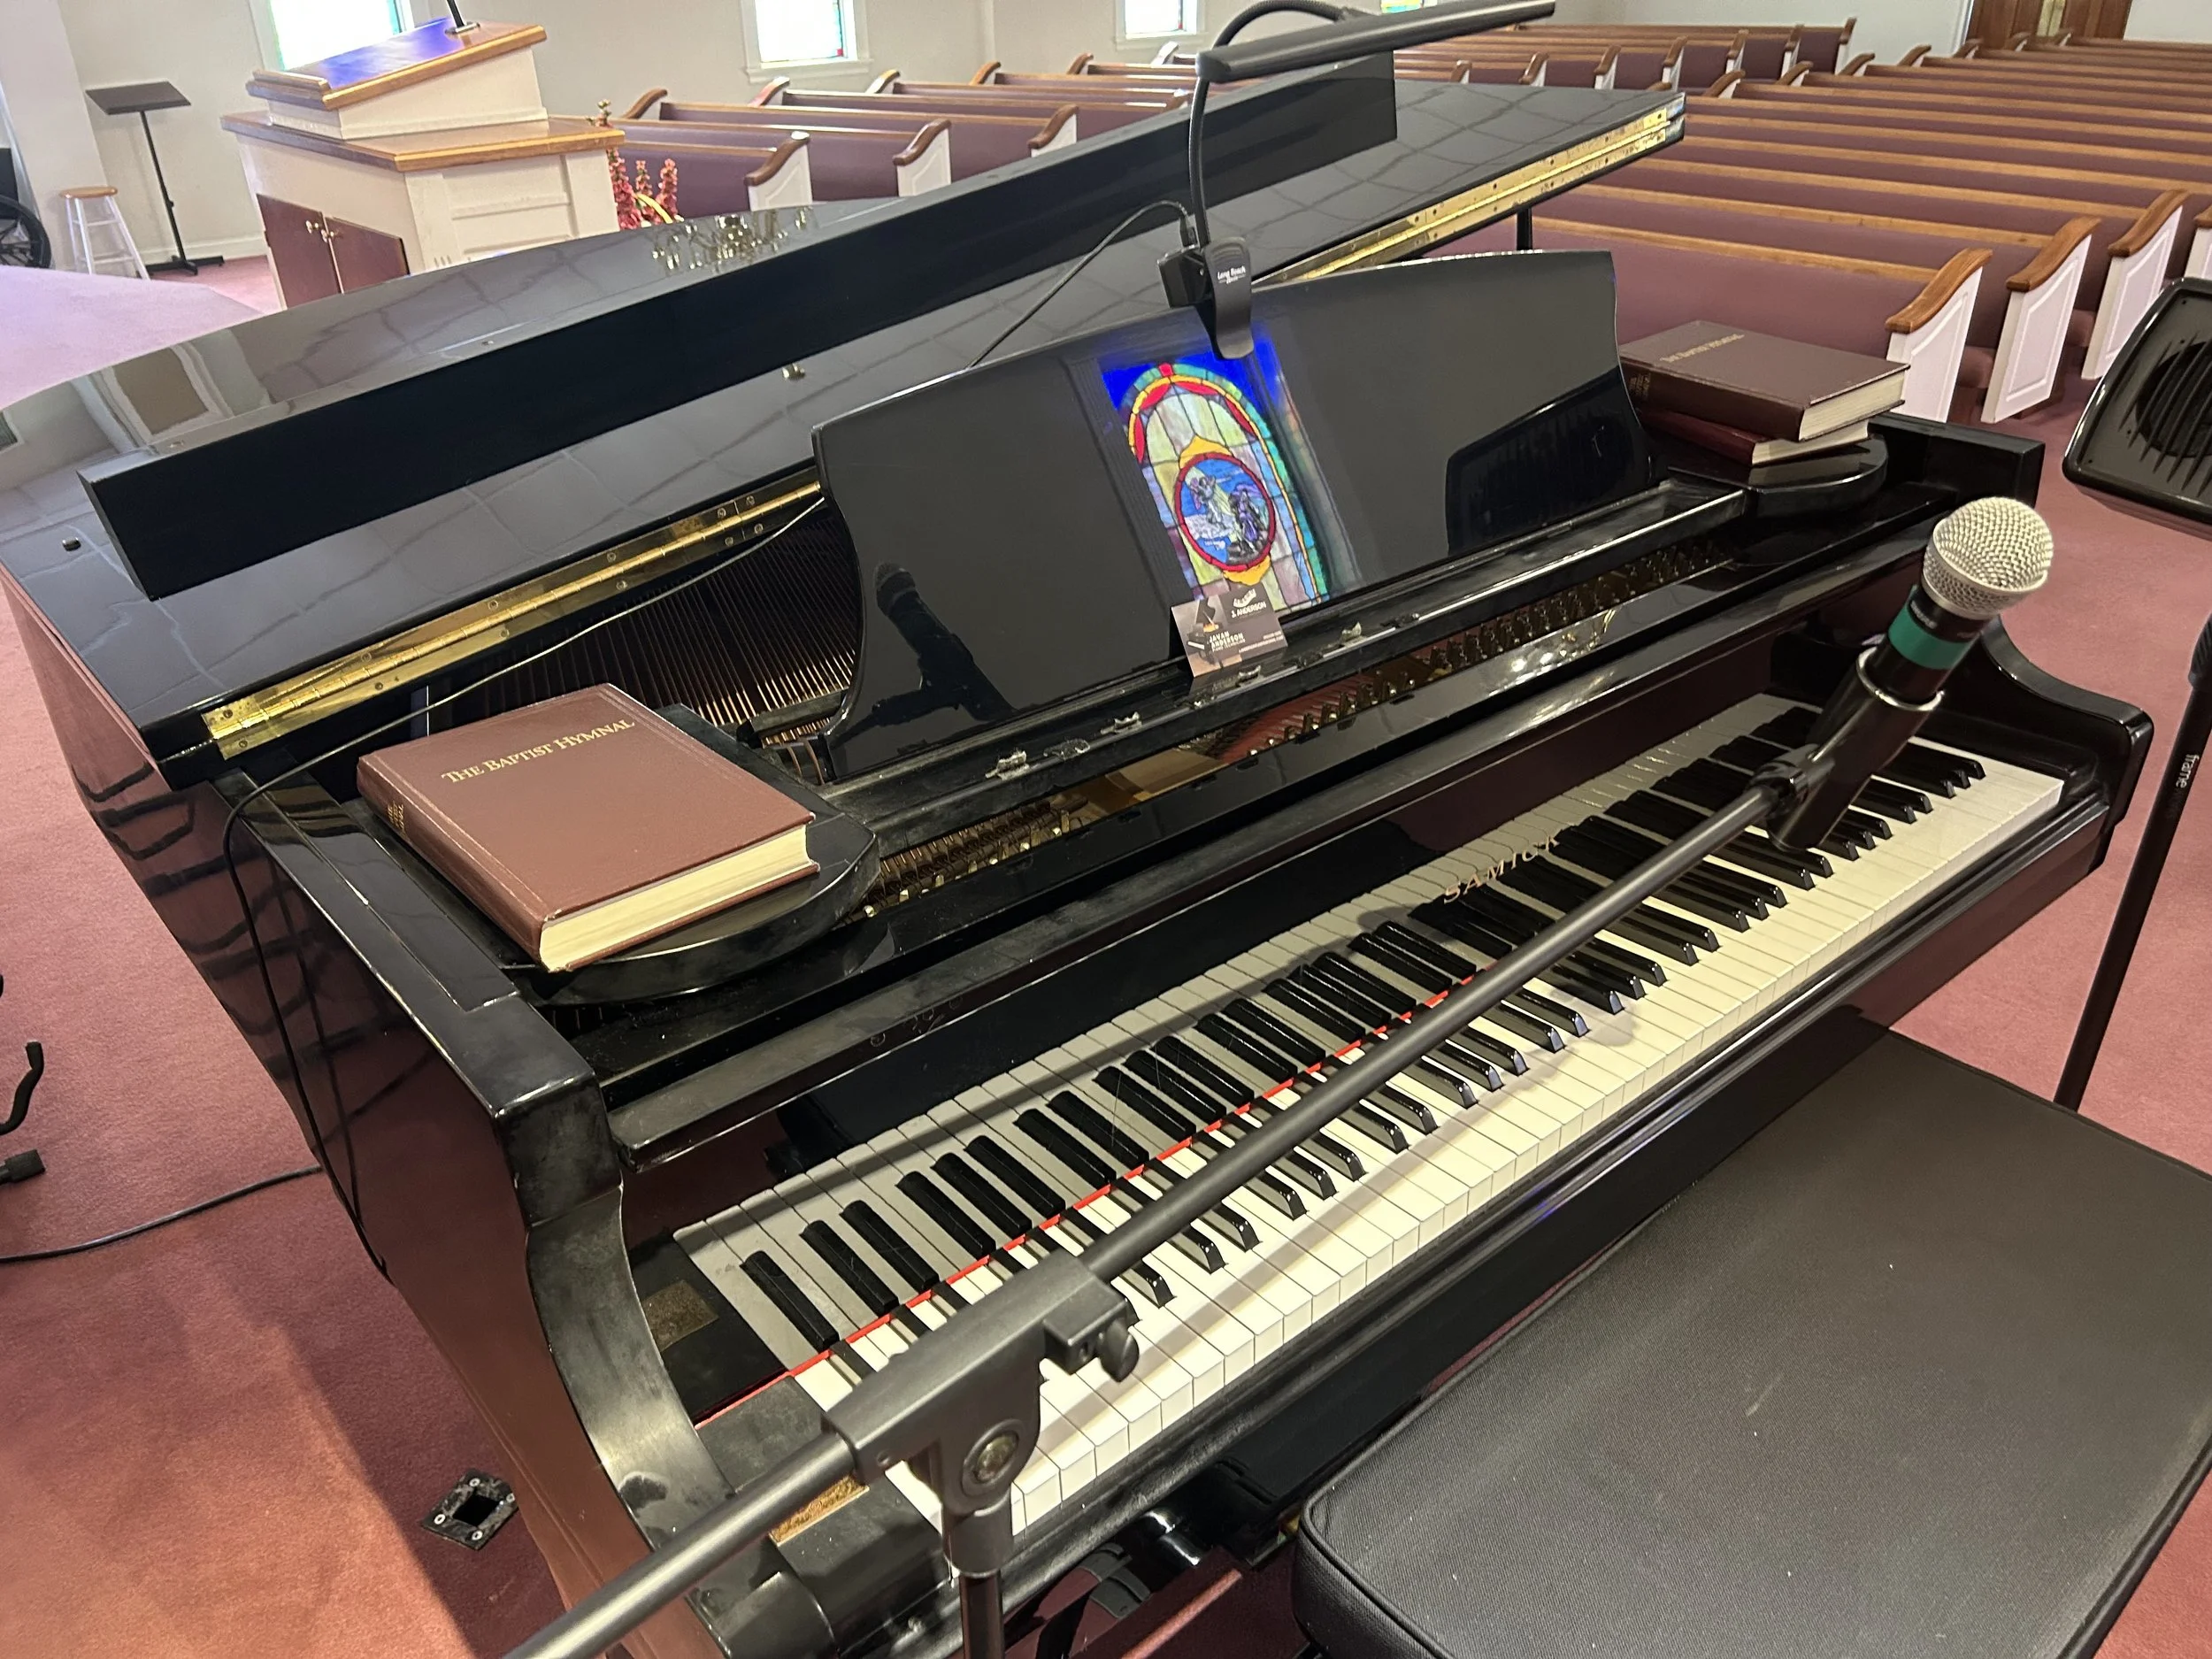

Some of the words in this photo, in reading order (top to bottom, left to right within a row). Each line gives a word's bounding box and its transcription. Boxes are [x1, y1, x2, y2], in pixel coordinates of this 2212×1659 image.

[1236, 601, 1267, 617] ANDERSON
[1209, 630, 1230, 643] JAVAN
[1210, 632, 1244, 649] ANDERSON
[441, 765, 485, 783] THE
[482, 743, 554, 772] BAPTIST
[553, 718, 635, 750] HYMNAL
[1443, 834, 1560, 904] SAMICK
